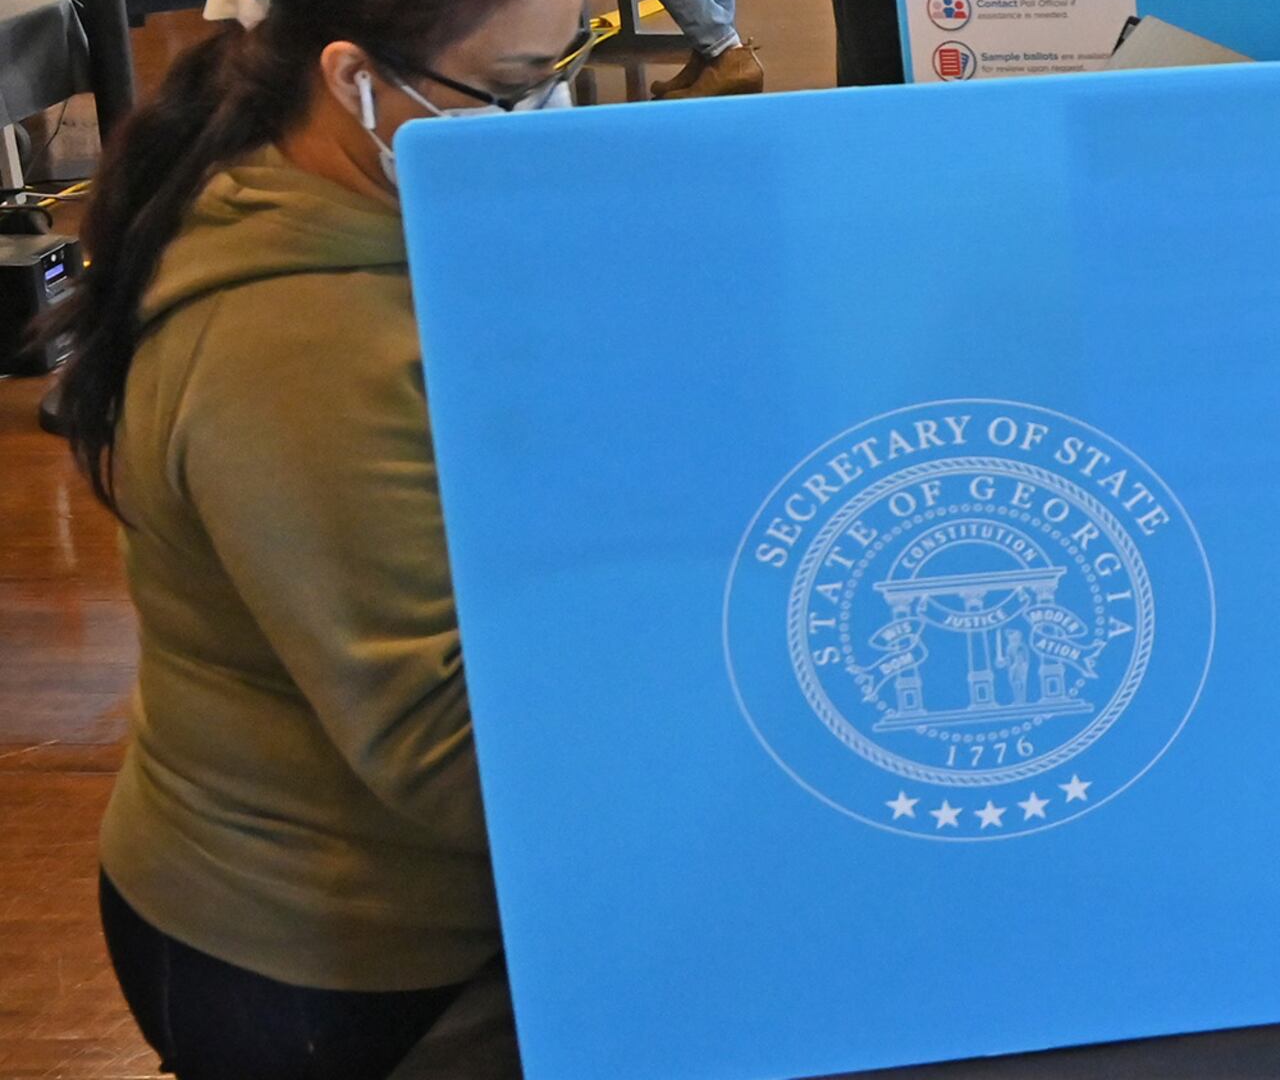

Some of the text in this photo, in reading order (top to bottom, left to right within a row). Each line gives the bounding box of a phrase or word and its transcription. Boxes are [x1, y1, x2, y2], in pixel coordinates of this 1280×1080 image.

[976, 0, 1018, 8] Contact
[981, 53, 1059, 63] Sample ballots
[754, 414, 1171, 569] SECRETARY OF STATE
[901, 523, 1037, 569] CONSTITUTION
[810, 476, 1134, 667] STATE OF GEORGIA
[943, 611, 1007, 629] JUSTICE
[1035, 638, 1082, 661] ATION
[945, 737, 1034, 768] 1776
